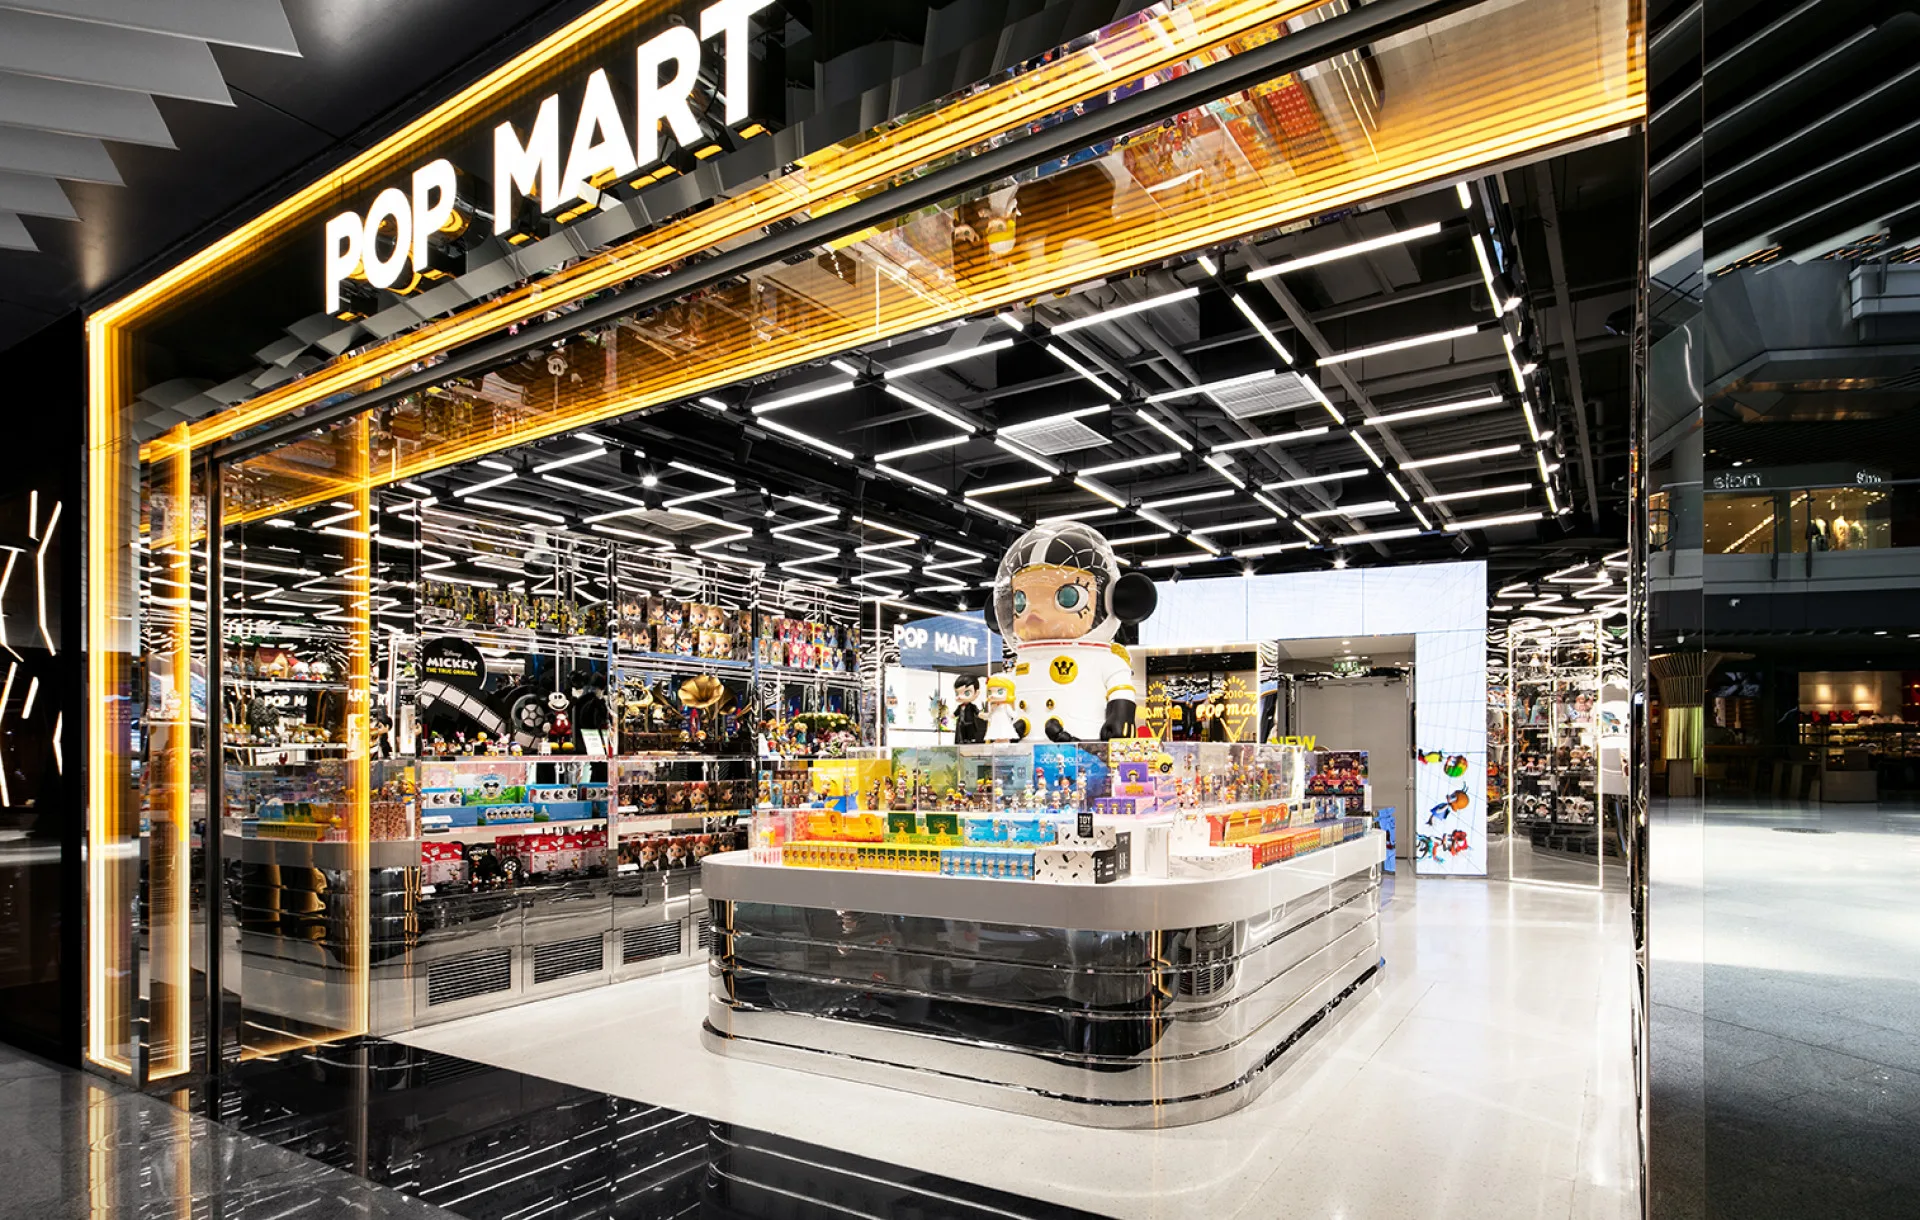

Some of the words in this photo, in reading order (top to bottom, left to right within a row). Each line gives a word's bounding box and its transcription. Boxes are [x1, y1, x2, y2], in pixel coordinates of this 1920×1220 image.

[325, 158, 457, 314] POP
[493, 0, 776, 237] MART
[893, 624, 928, 649] POP
[934, 631, 978, 657] MART
[426, 657, 478, 670] MICKEY
[1224, 690, 1244, 699] 2010
[1272, 735, 1316, 751] NEW
[1079, 816, 1091, 824] TOY
